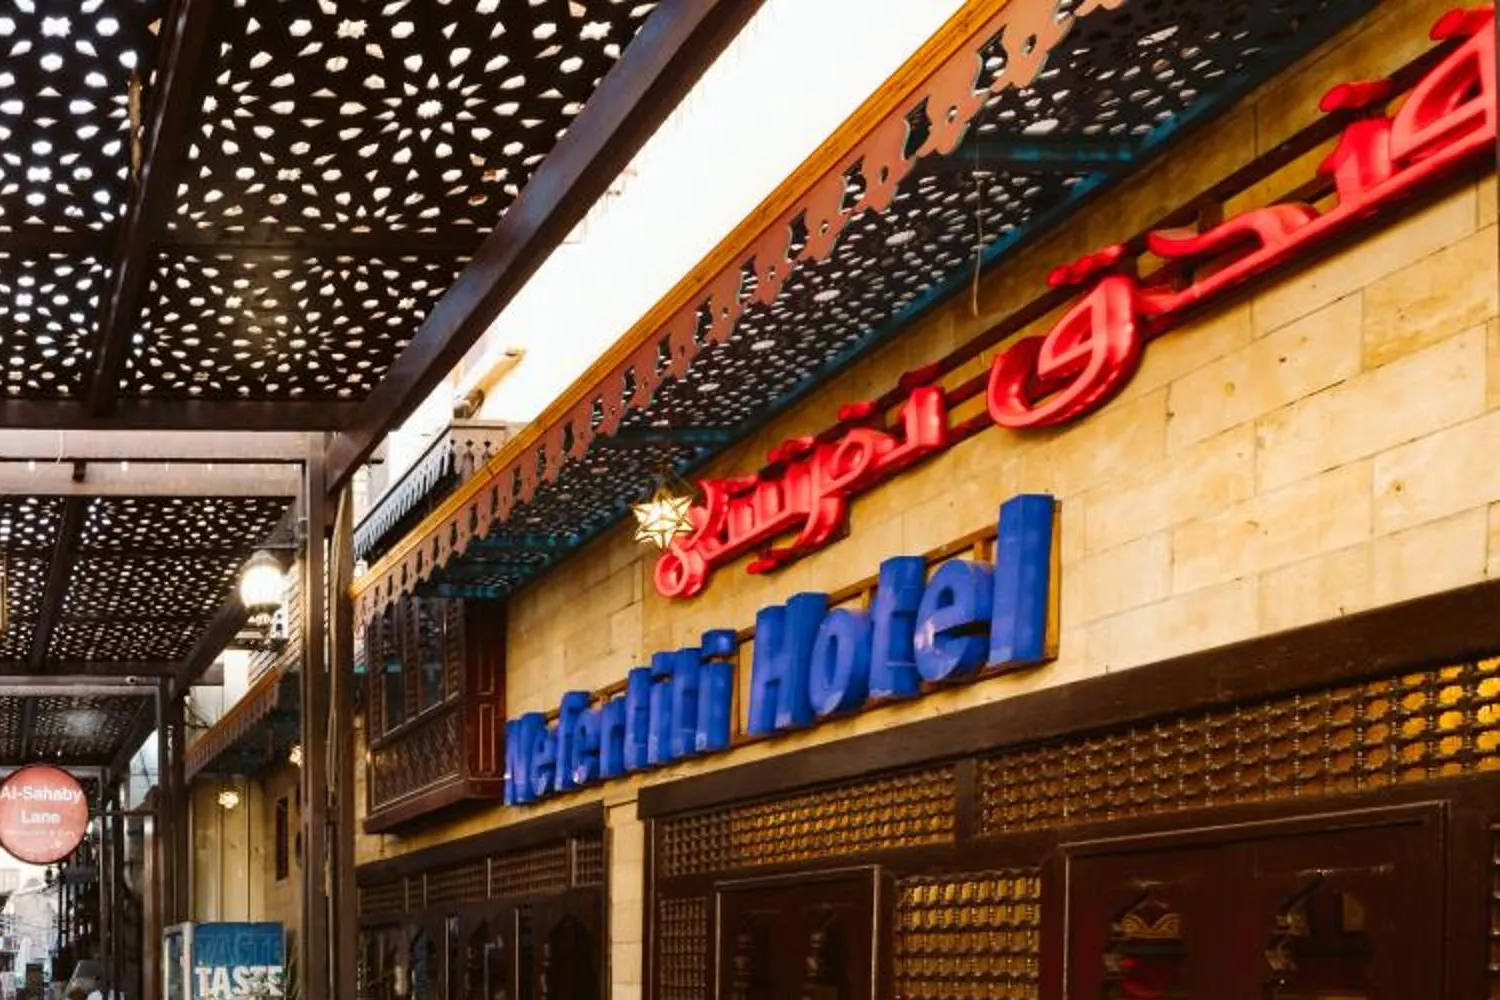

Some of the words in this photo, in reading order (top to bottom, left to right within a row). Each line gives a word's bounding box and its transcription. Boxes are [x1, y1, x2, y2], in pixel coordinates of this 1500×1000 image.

[988, 6, 1496, 428] فندق
[748, 493, 1055, 736] Hotel
[0, 783, 82, 805] Al-Sahaby
[20, 809, 62, 825] Lane
